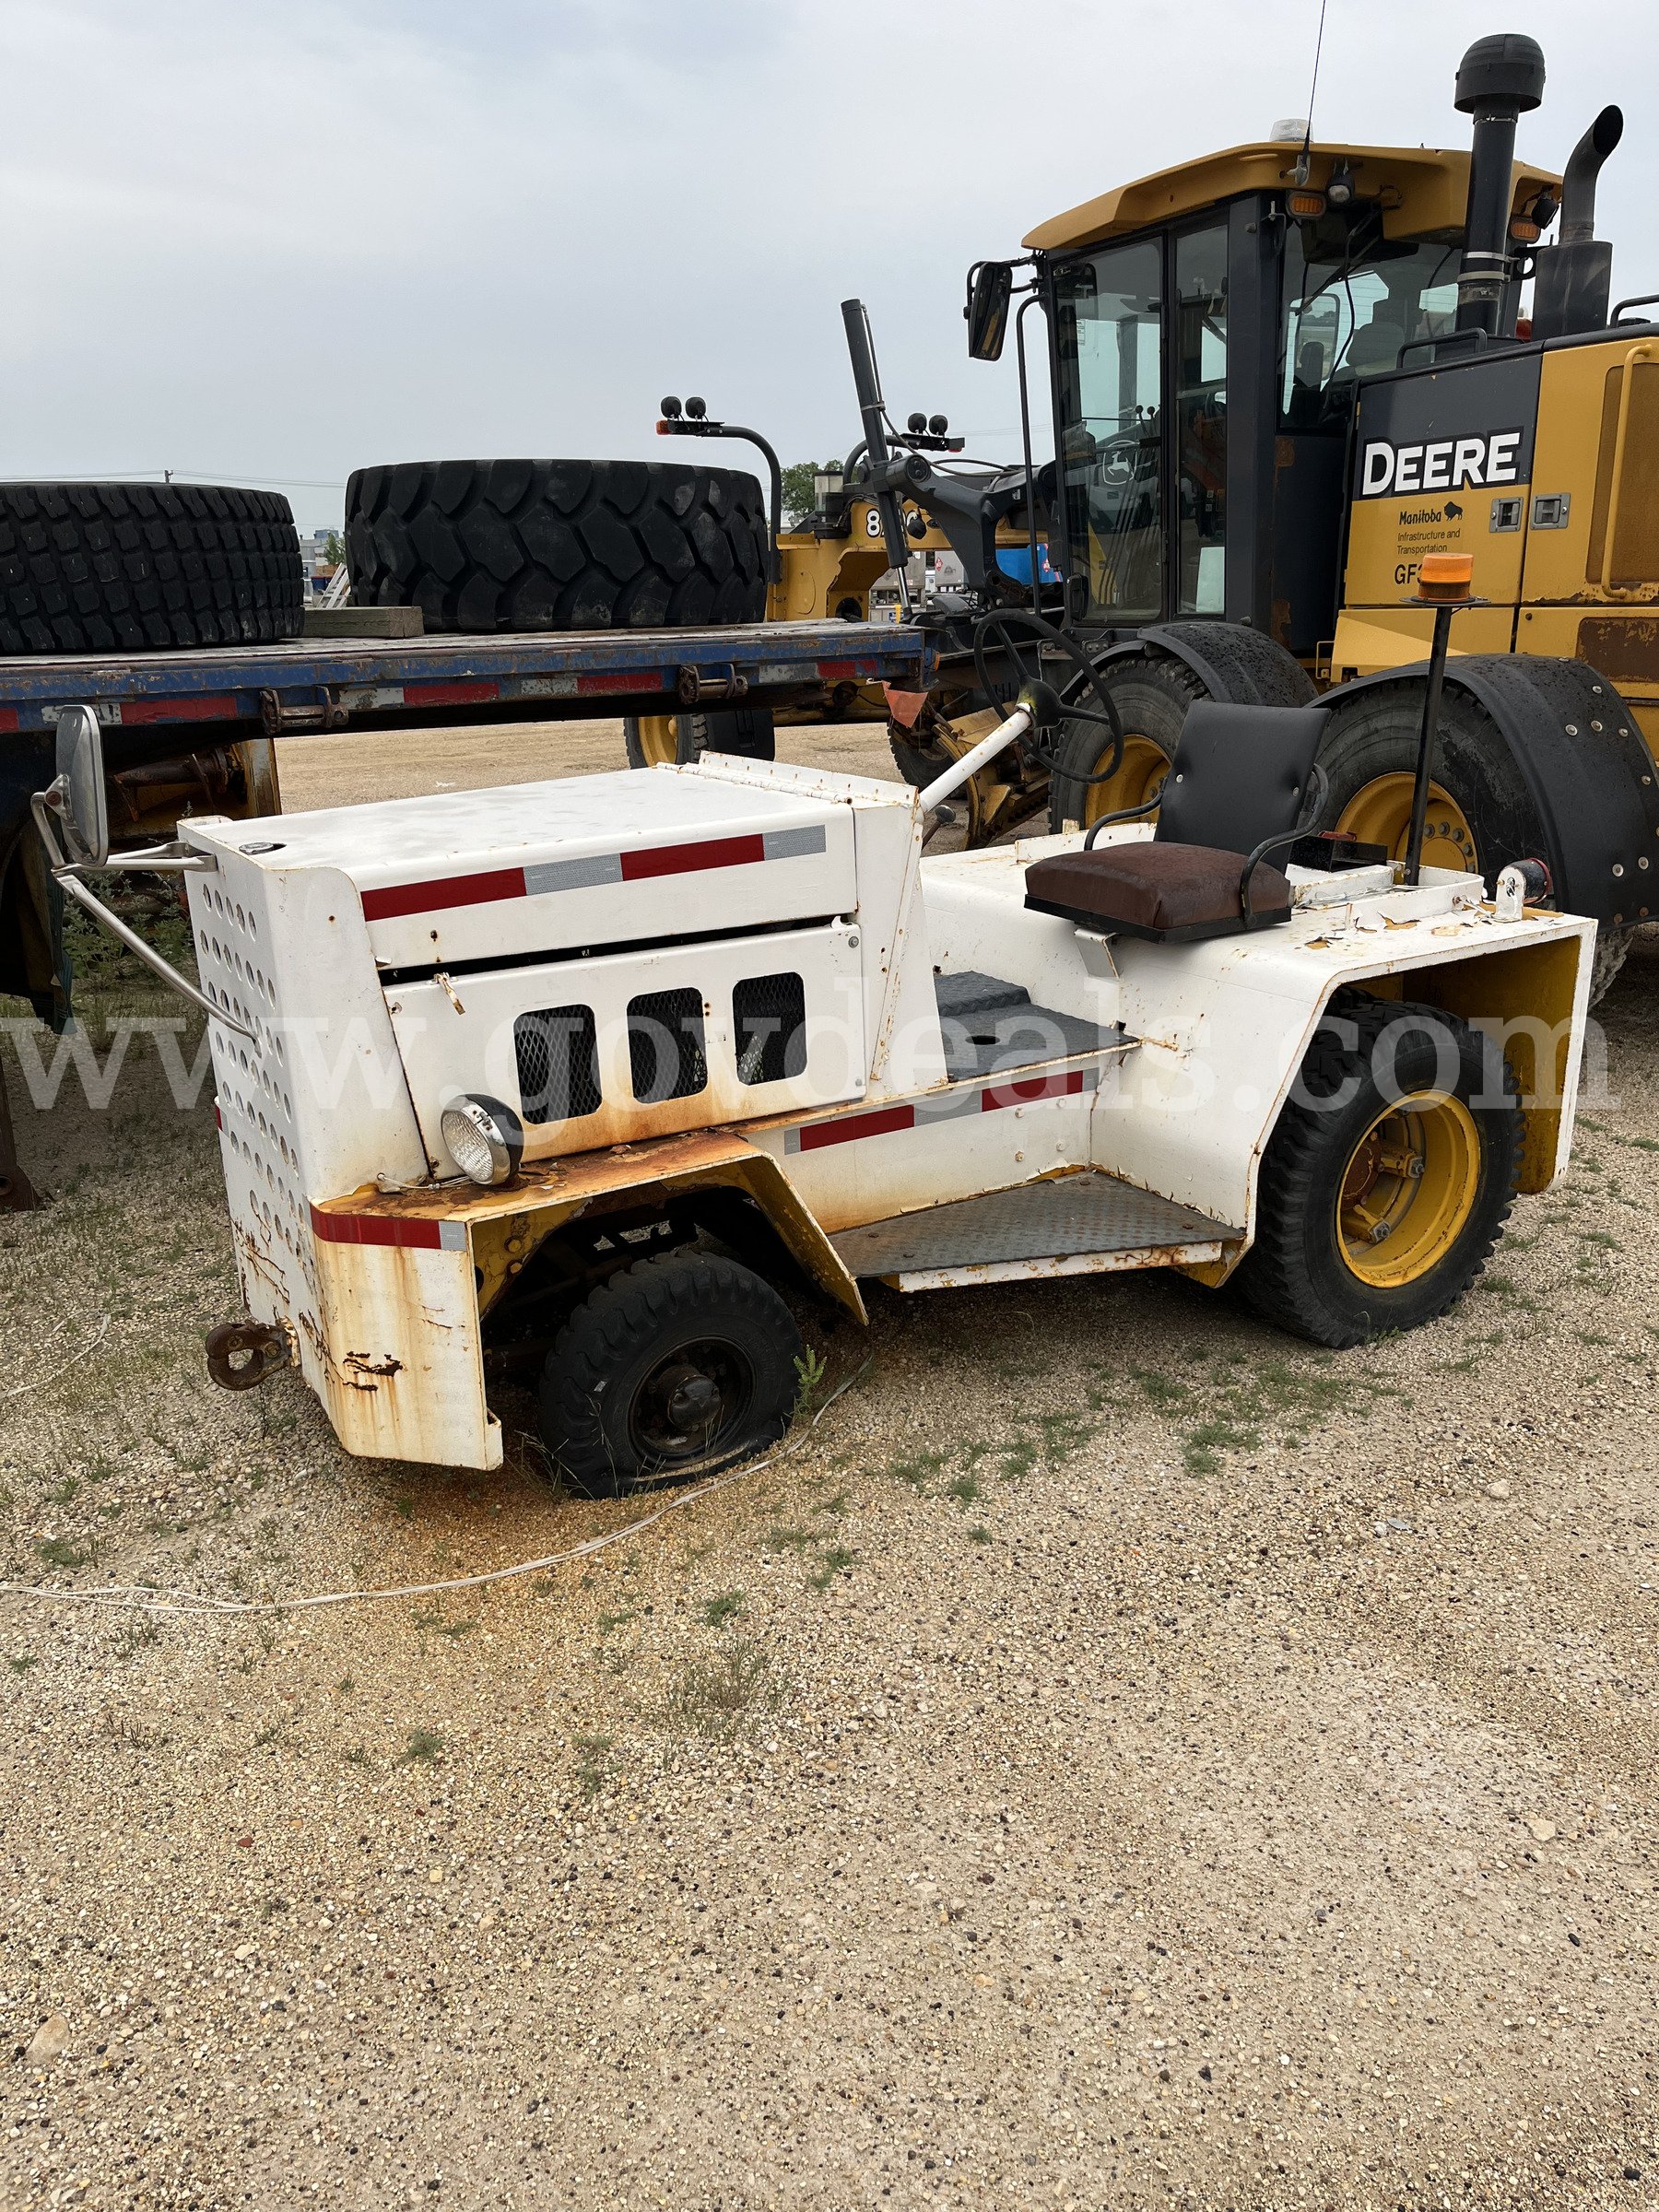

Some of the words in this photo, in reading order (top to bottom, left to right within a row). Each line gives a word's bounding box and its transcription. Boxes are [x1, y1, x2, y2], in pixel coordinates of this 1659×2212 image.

[1362, 432, 1520, 495] DEERE
[1399, 509, 1441, 525] Manitoba
[1397, 530, 1445, 542] Infrastructure
[1447, 528, 1461, 538] and
[1397, 544, 1447, 555] Transportation
